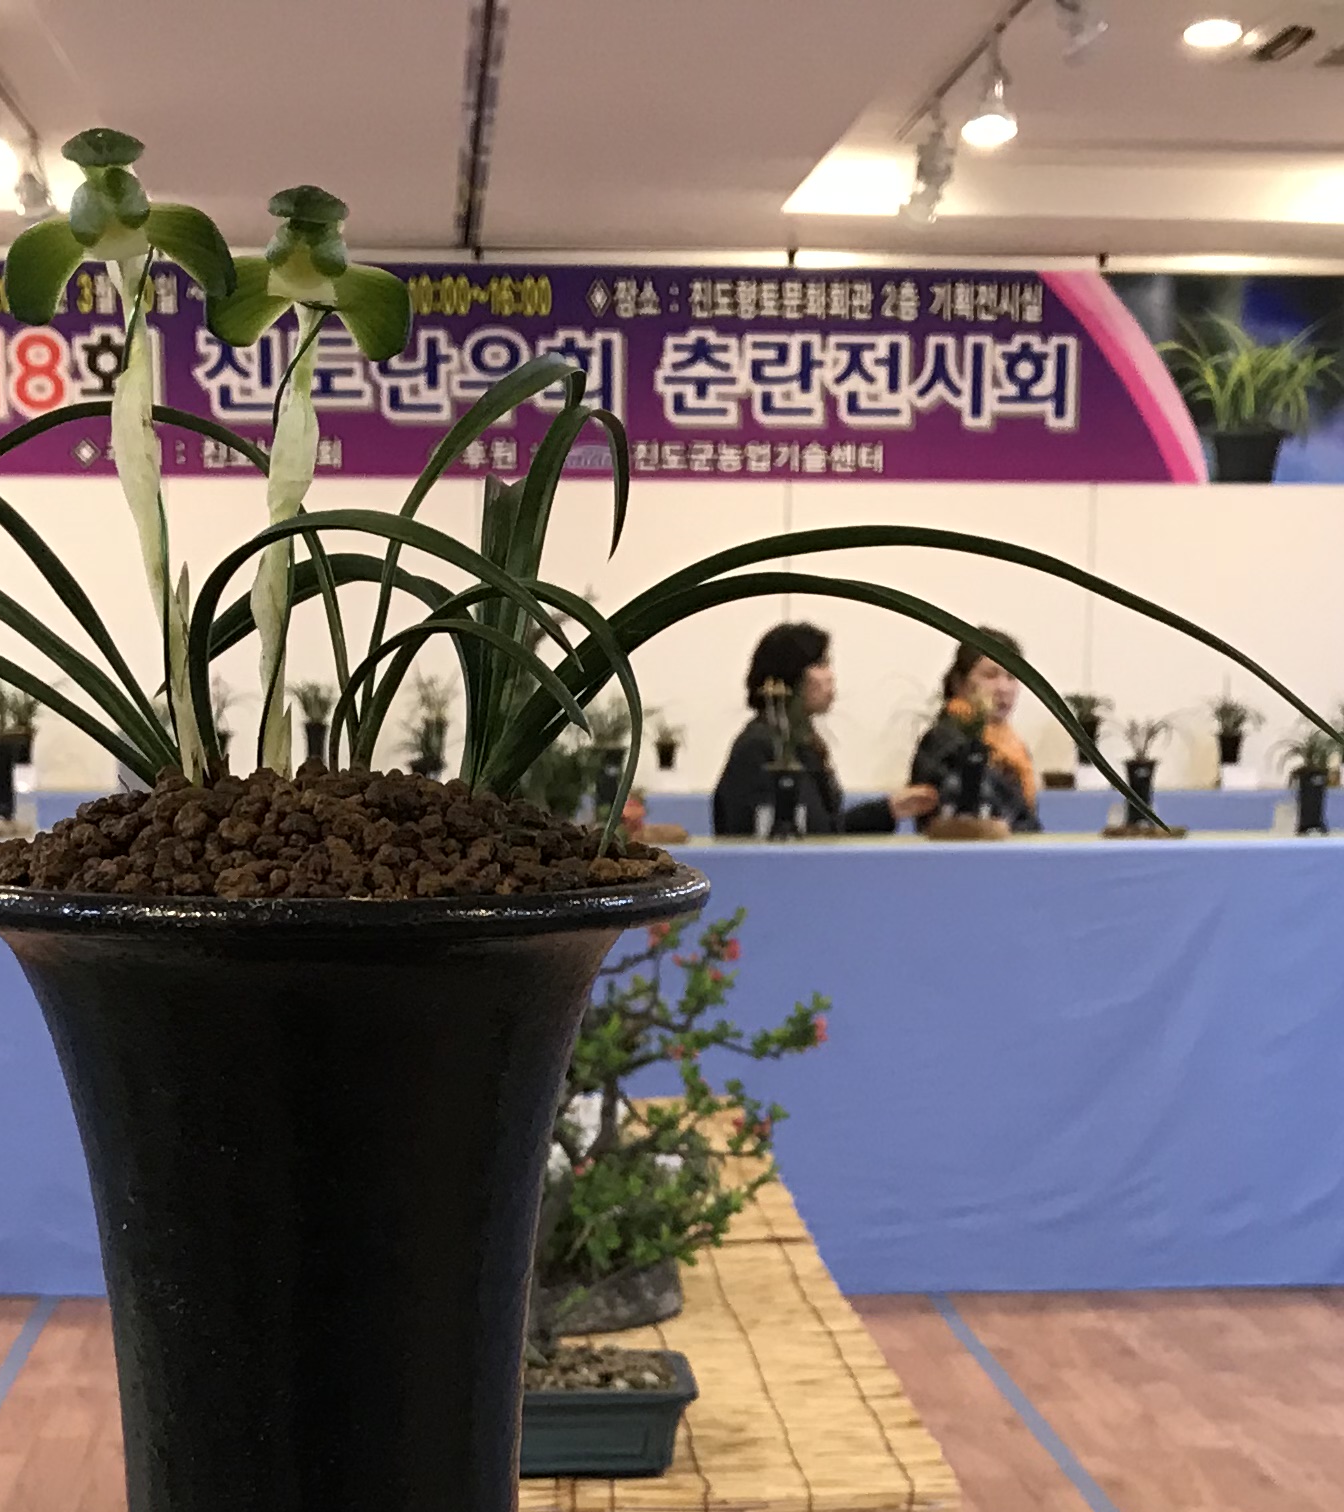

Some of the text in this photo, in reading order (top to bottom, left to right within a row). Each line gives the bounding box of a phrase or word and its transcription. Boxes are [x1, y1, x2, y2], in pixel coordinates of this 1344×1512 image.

[612, 275, 662, 319] 장소
[880, 279, 920, 323] 2층
[928, 279, 1044, 324] 기획전시실
[649, 327, 1078, 428] 춘란전시회
[631, 440, 886, 473] 진도군농업기술센터
